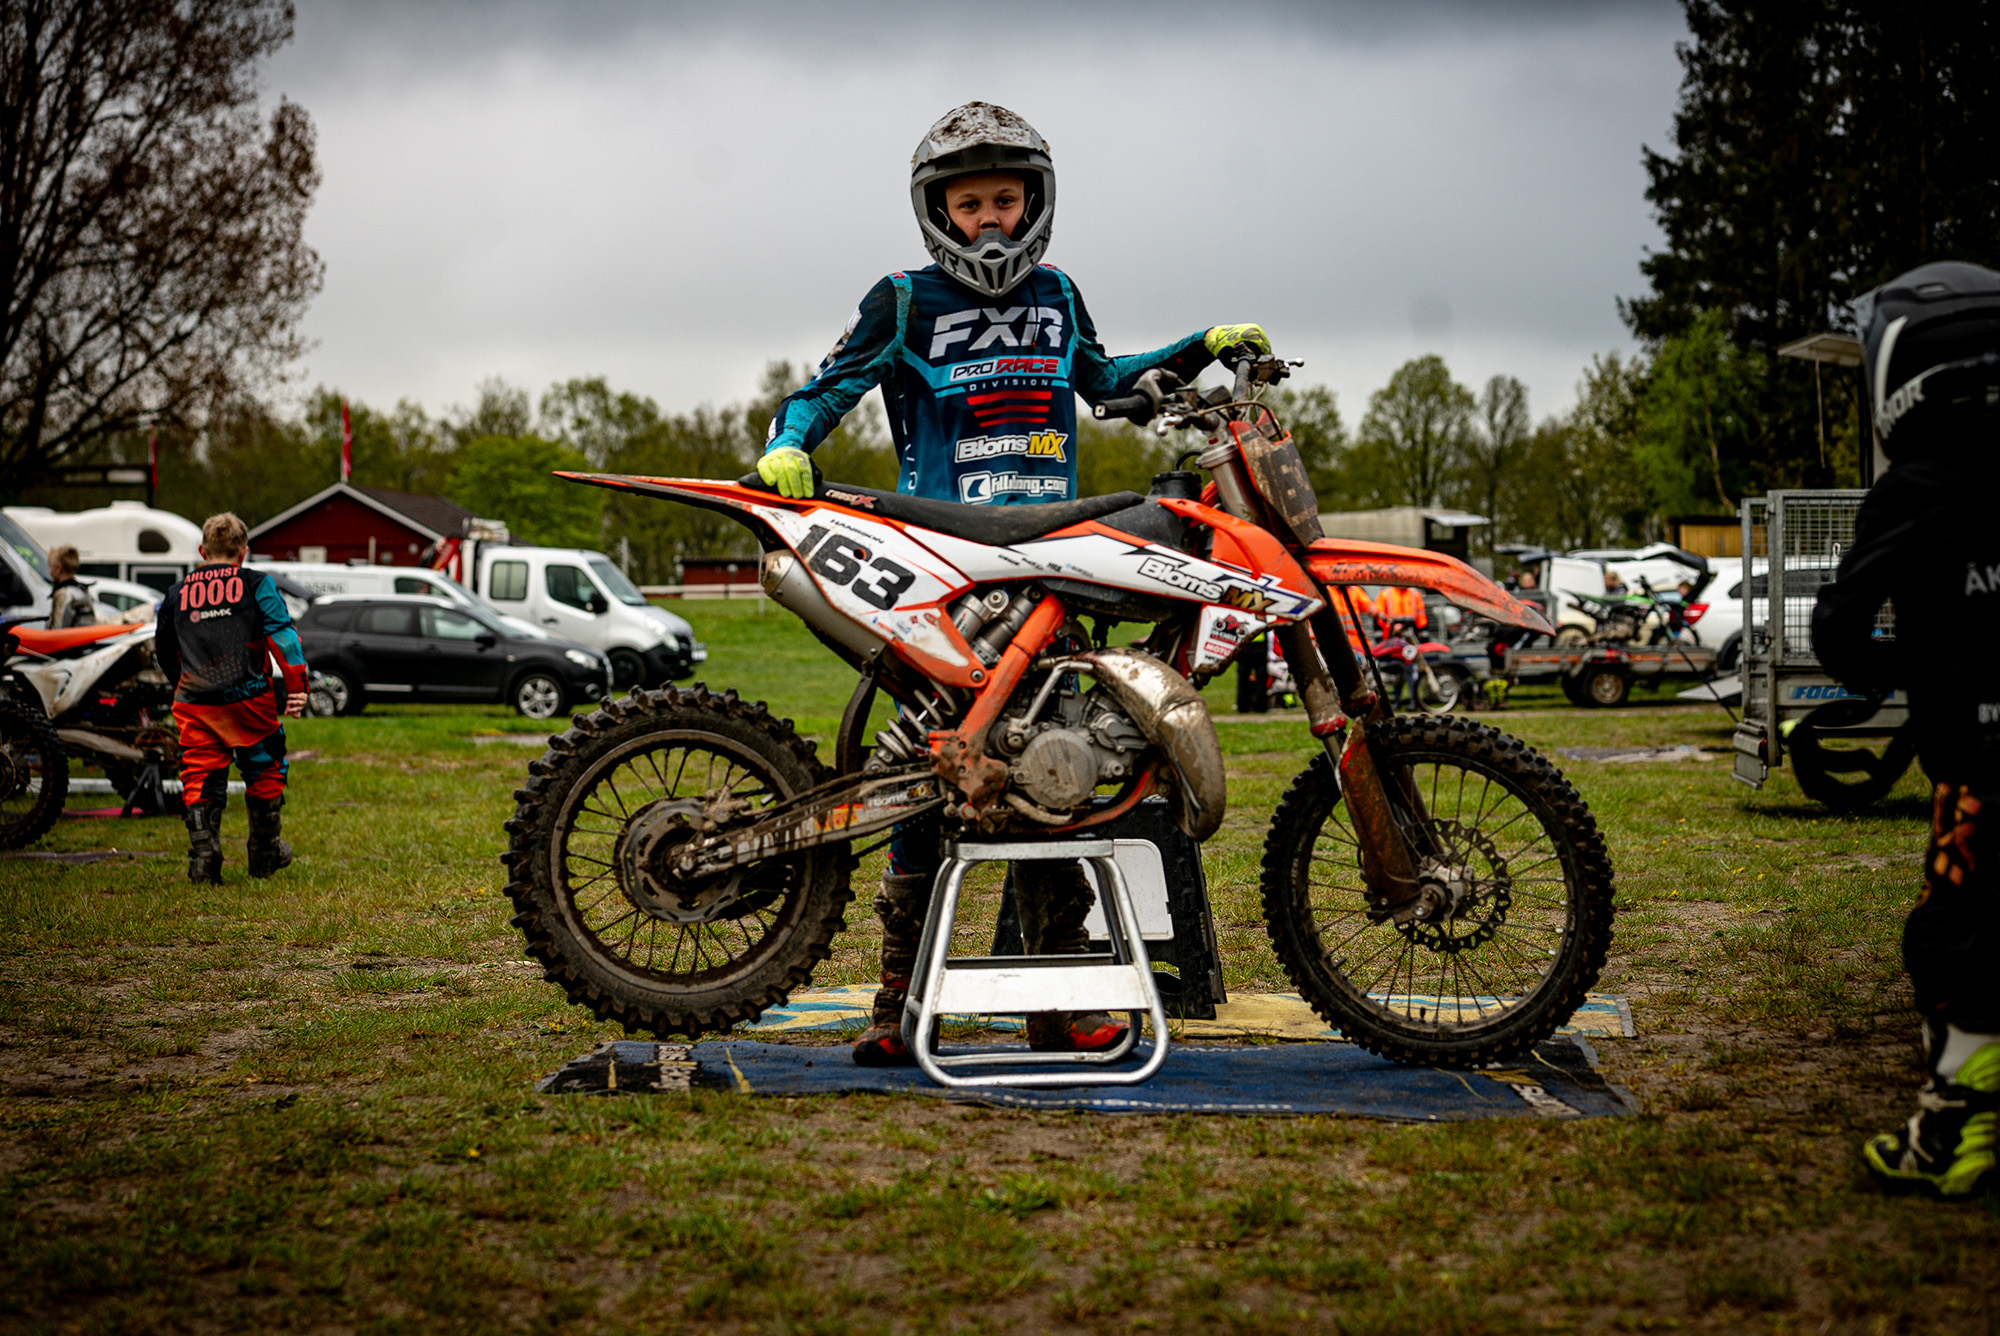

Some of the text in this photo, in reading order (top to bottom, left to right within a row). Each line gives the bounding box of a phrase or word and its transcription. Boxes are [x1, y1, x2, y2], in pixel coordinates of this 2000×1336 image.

[929, 306, 1063, 359] FXR
[952, 358, 1059, 379] PRO RACE
[969, 379, 1049, 391] DIVISION
[184, 567, 240, 583] AHLQVIST
[796, 524, 916, 610] 163
[179, 576, 244, 612] 1000
